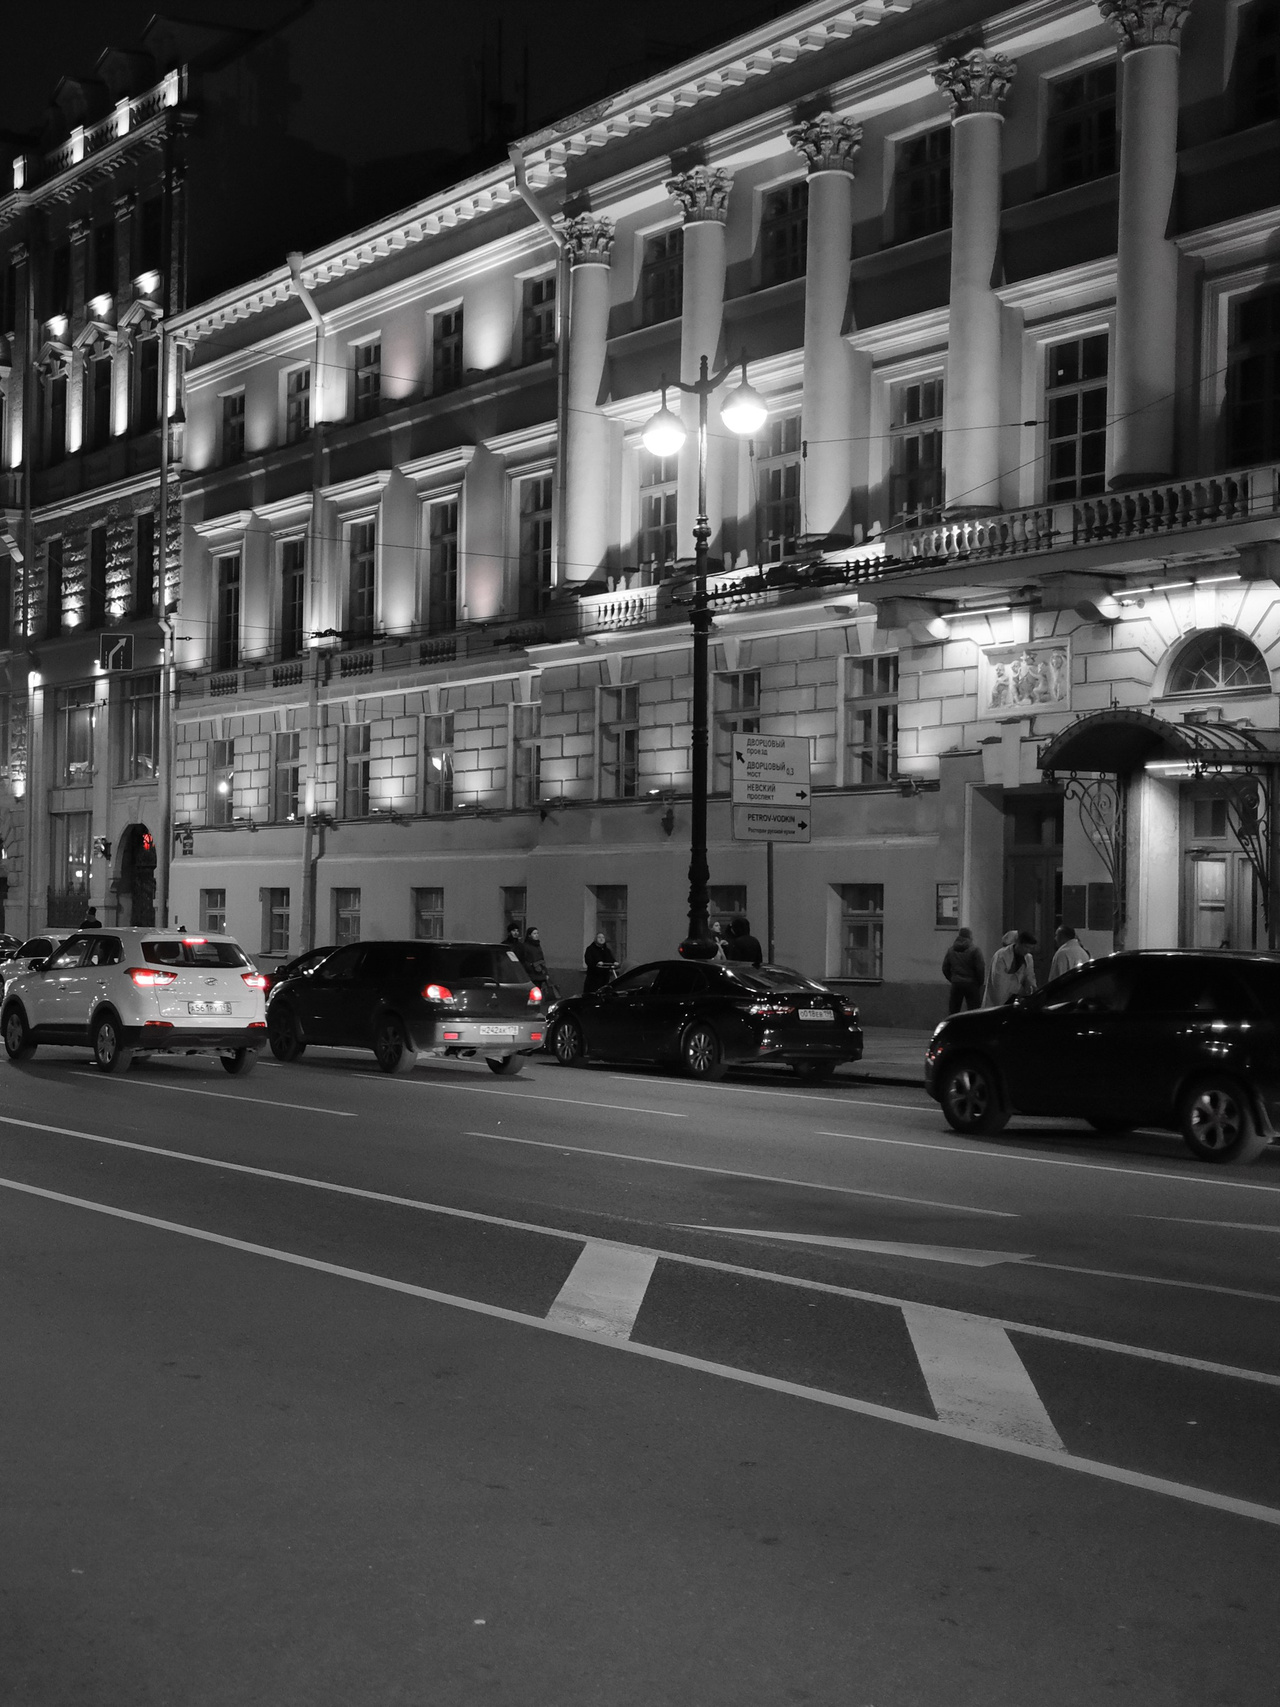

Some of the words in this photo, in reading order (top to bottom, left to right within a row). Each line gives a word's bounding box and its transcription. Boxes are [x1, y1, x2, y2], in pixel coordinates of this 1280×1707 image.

[746, 738, 786, 748] ДВОРЦОВЫЙ
[746, 761, 786, 771] ДВОРЦОВЫЙ
[746, 783, 776, 792] НЕВСКИЙ
[747, 813, 796, 823] PETROV-VODKIN
